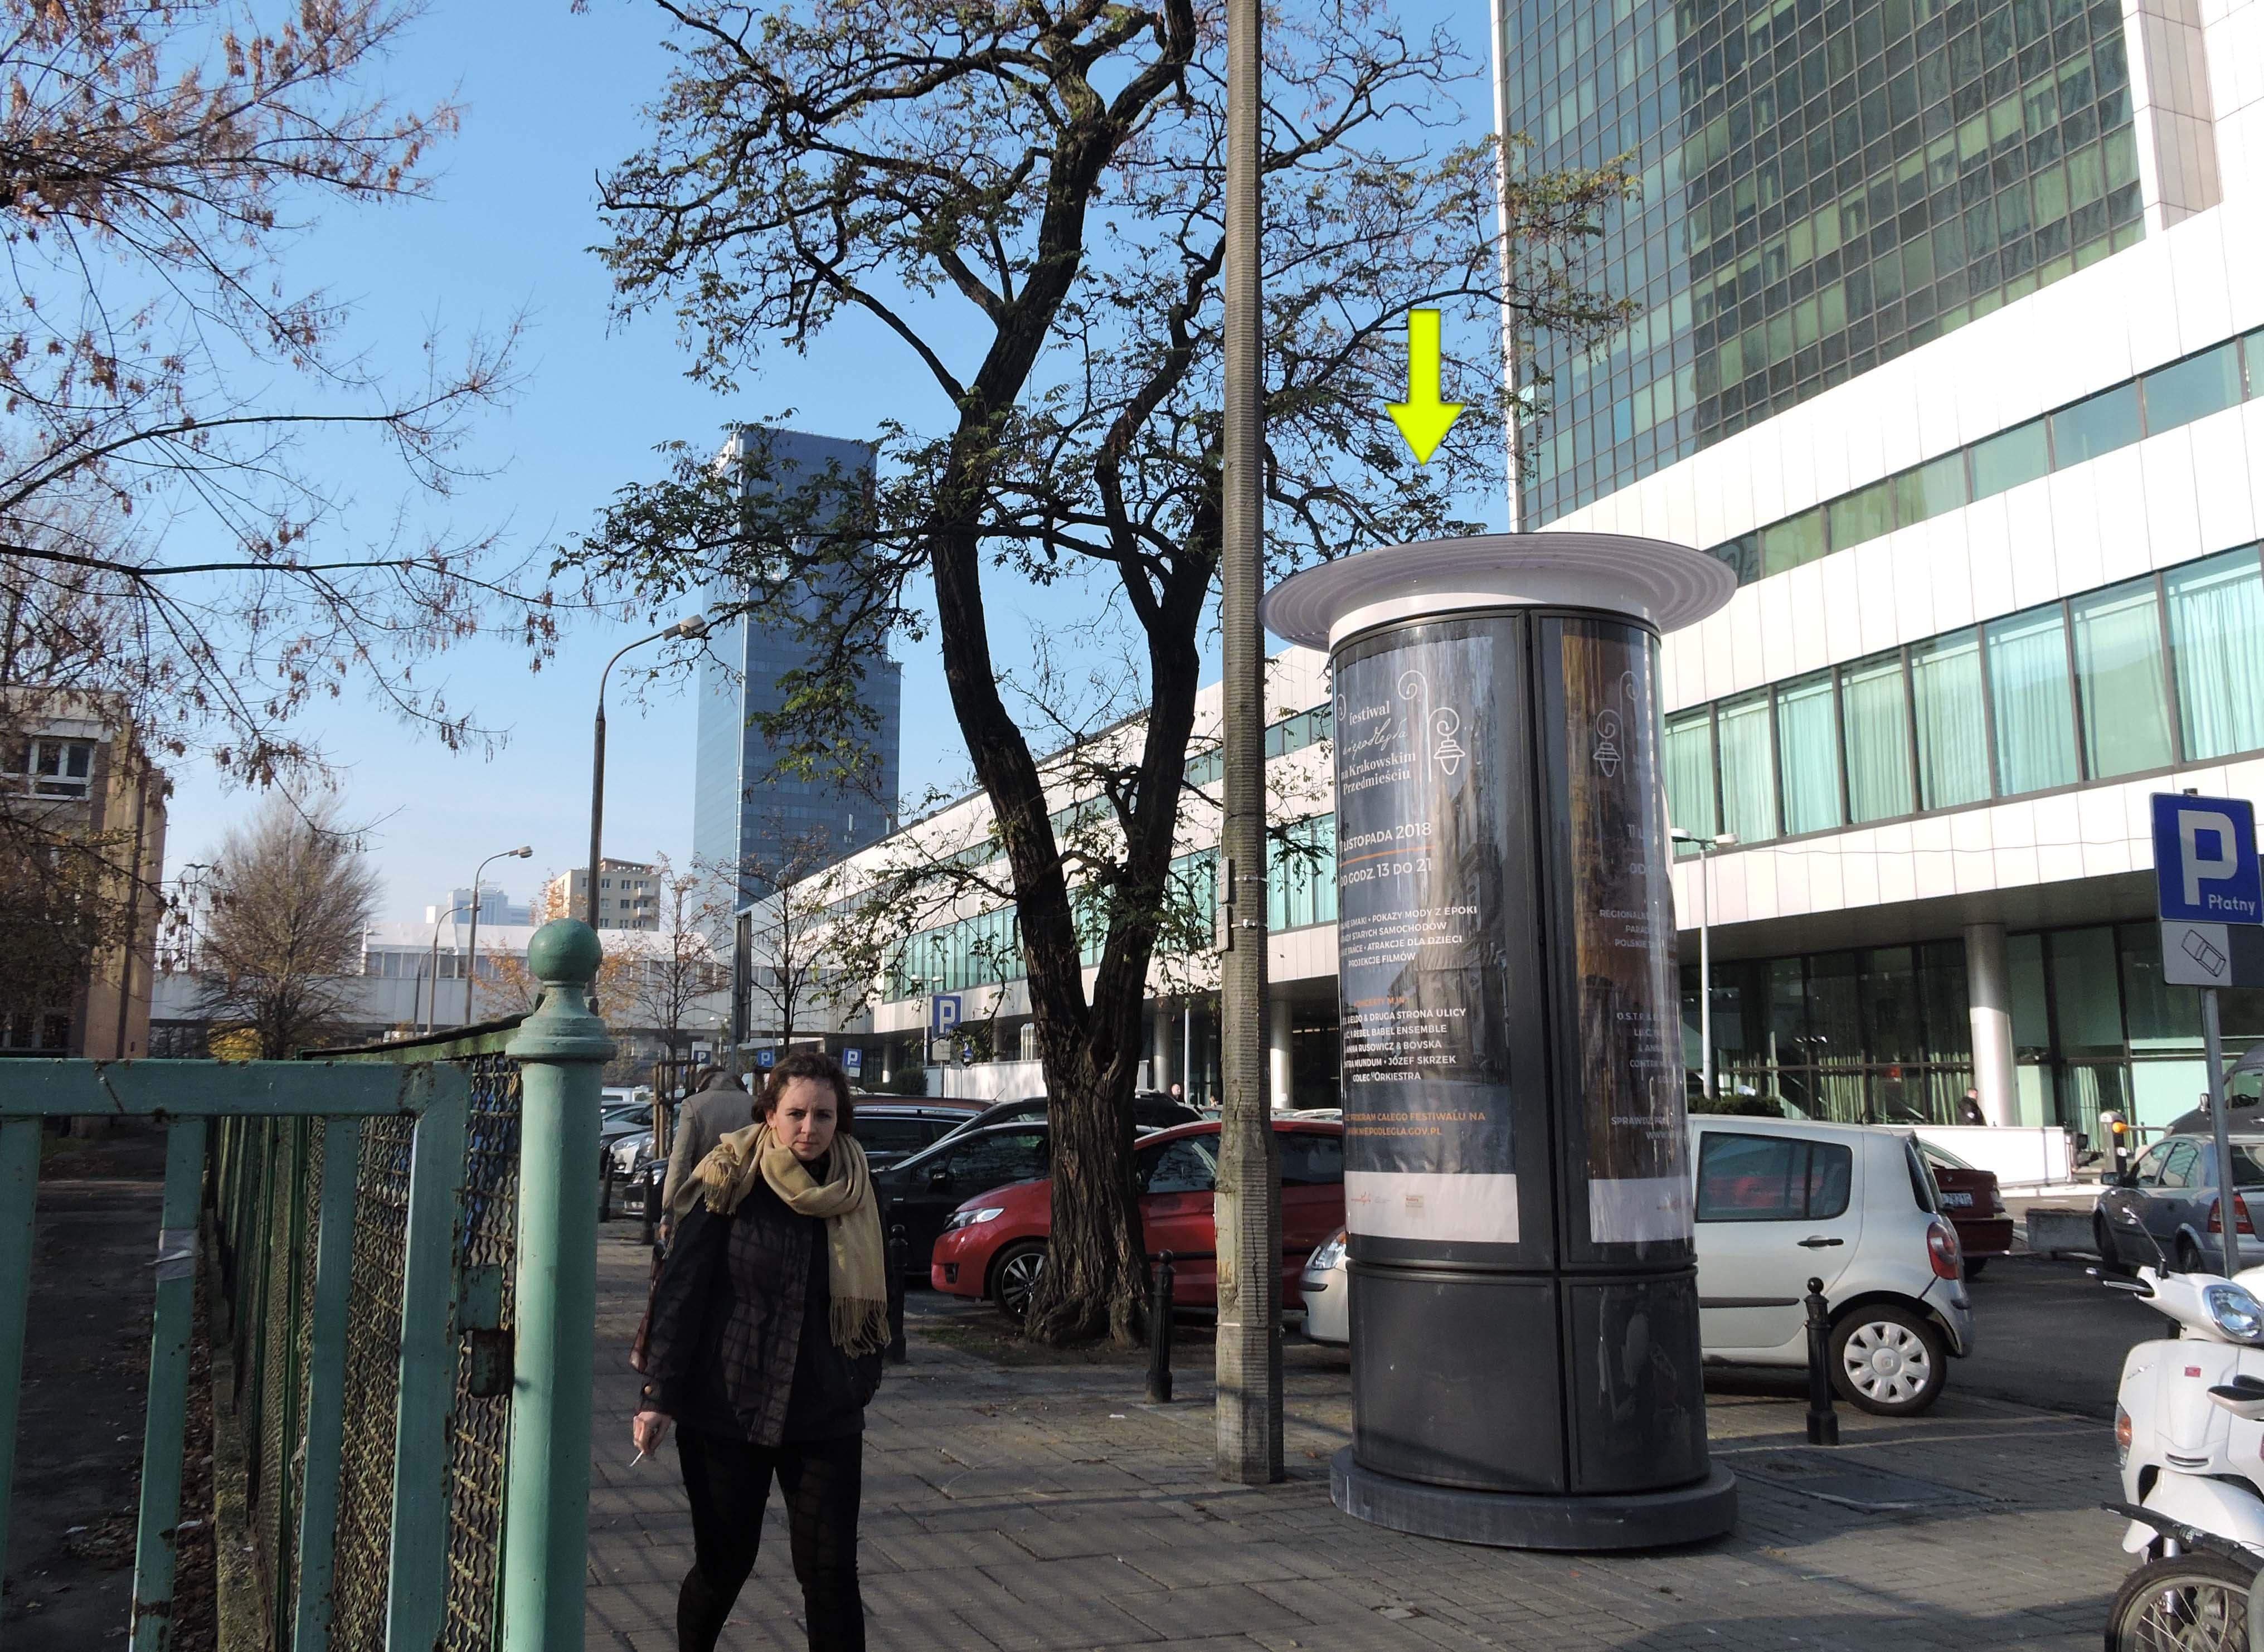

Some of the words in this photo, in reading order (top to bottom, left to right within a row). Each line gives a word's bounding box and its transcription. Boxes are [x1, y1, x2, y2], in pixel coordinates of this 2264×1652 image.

[1349, 701, 1390, 725] festiwal
[1349, 751, 1416, 778] Krakowskim
[1343, 769, 1411, 795] Przedmieściu
[1343, 829, 1393, 852] LISTOPADA
[1395, 822, 1432, 839] 2018
[2178, 809, 2238, 906] P
[1348, 867, 1376, 885] GODZ.
[1377, 863, 1390, 878] 13
[1393, 862, 1413, 876] DO
[1416, 857, 1432, 872] 21
[2207, 893, 2256, 916] Płatny
[1372, 911, 1403, 924] POKAZY
[1405, 908, 1432, 919] MODY
[1434, 907, 1441, 916] Z
[1444, 905, 1478, 915] EPOKI
[1352, 928, 1378, 940] STARYCH
[1367, 939, 1405, 951] ATRAKCJE
[1407, 937, 1426, 946] DLA
[1427, 935, 1463, 945] DZIECI
[1348, 955, 1381, 968] PROJEKCJE
[1382, 950, 1416, 964] FILMÓW
[939, 999, 956, 1034] P
[1364, 1013, 1368, 1022] &
[1369, 1011, 1396, 1022] DRUGA
[1396, 1009, 1434, 1020] STRONA
[1436, 1008, 1467, 1017] ULICY
[1353, 1028, 1371, 1038] REBEL
[1371, 1027, 1395, 1036] BABEL
[1396, 1024, 1447, 1036] ENSEMBLE
[1358, 1041, 1394, 1053] RUSOWICZ
[1396, 1041, 1402, 1051] &
[1403, 1039, 1442, 1050] BOVSKA
[697, 1051, 706, 1063] P
[761, 1052, 770, 1065] P
[847, 1051, 858, 1065] P
[1354, 1058, 1382, 1068] MUNDUM
[1388, 1055, 1415, 1067] JÓZEF
[1417, 1055, 1456, 1066] SKRZEK
[1410, 1111, 1466, 1121] FESTIWALU
[1469, 1112, 1486, 1121] NA
